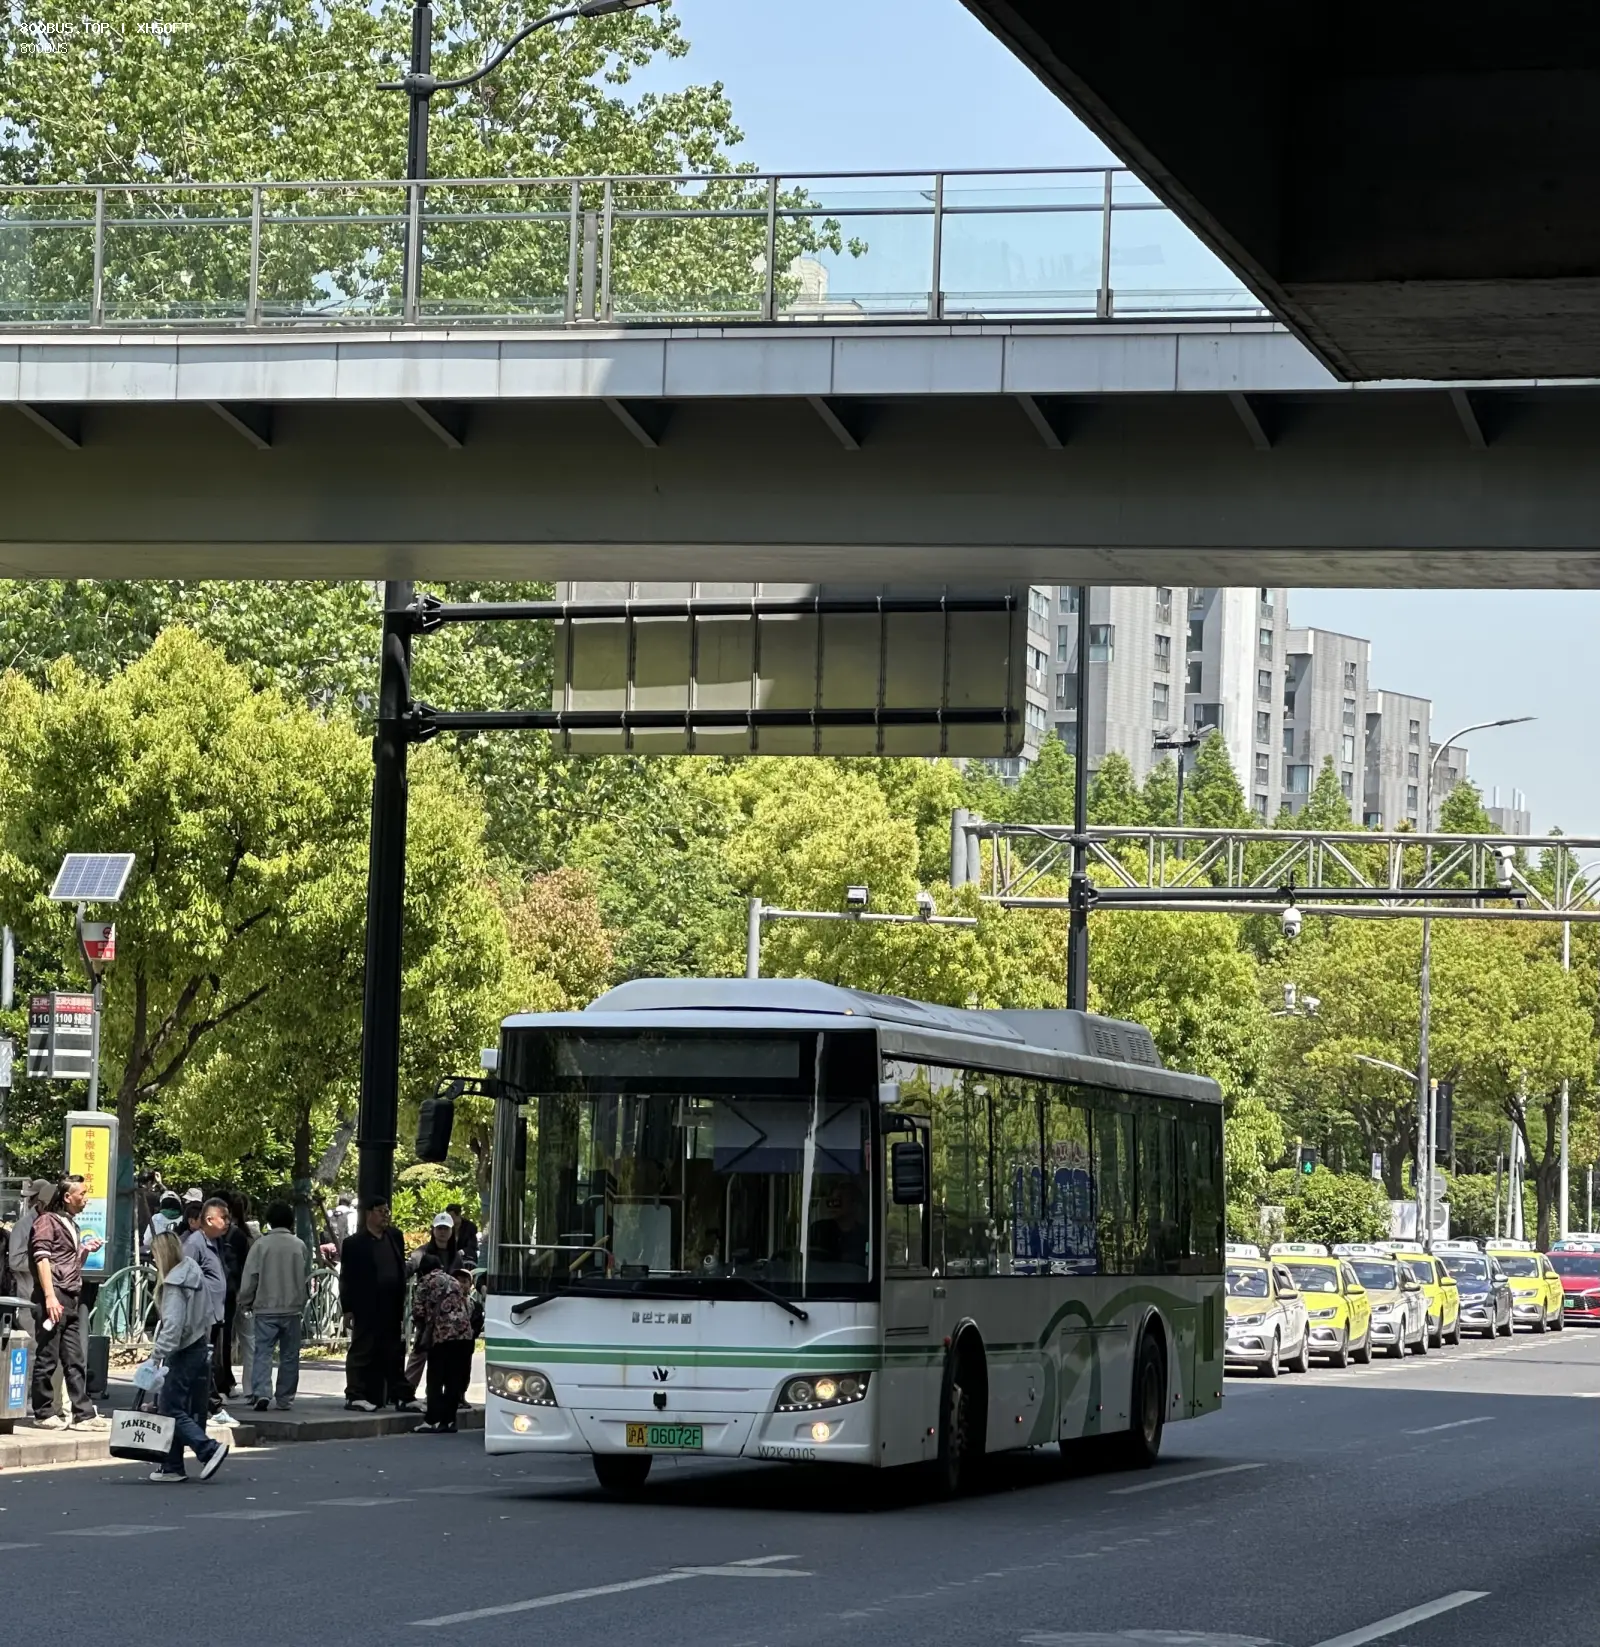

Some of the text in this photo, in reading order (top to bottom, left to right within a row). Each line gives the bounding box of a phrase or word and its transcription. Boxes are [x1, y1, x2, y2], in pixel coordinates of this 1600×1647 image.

[55, 1013, 73, 1024] 1100
[84, 1128, 95, 1194] 申崇线下客站
[121, 1419, 162, 1434] YANKEES
[757, 1446, 816, 1461] W2K-0105
